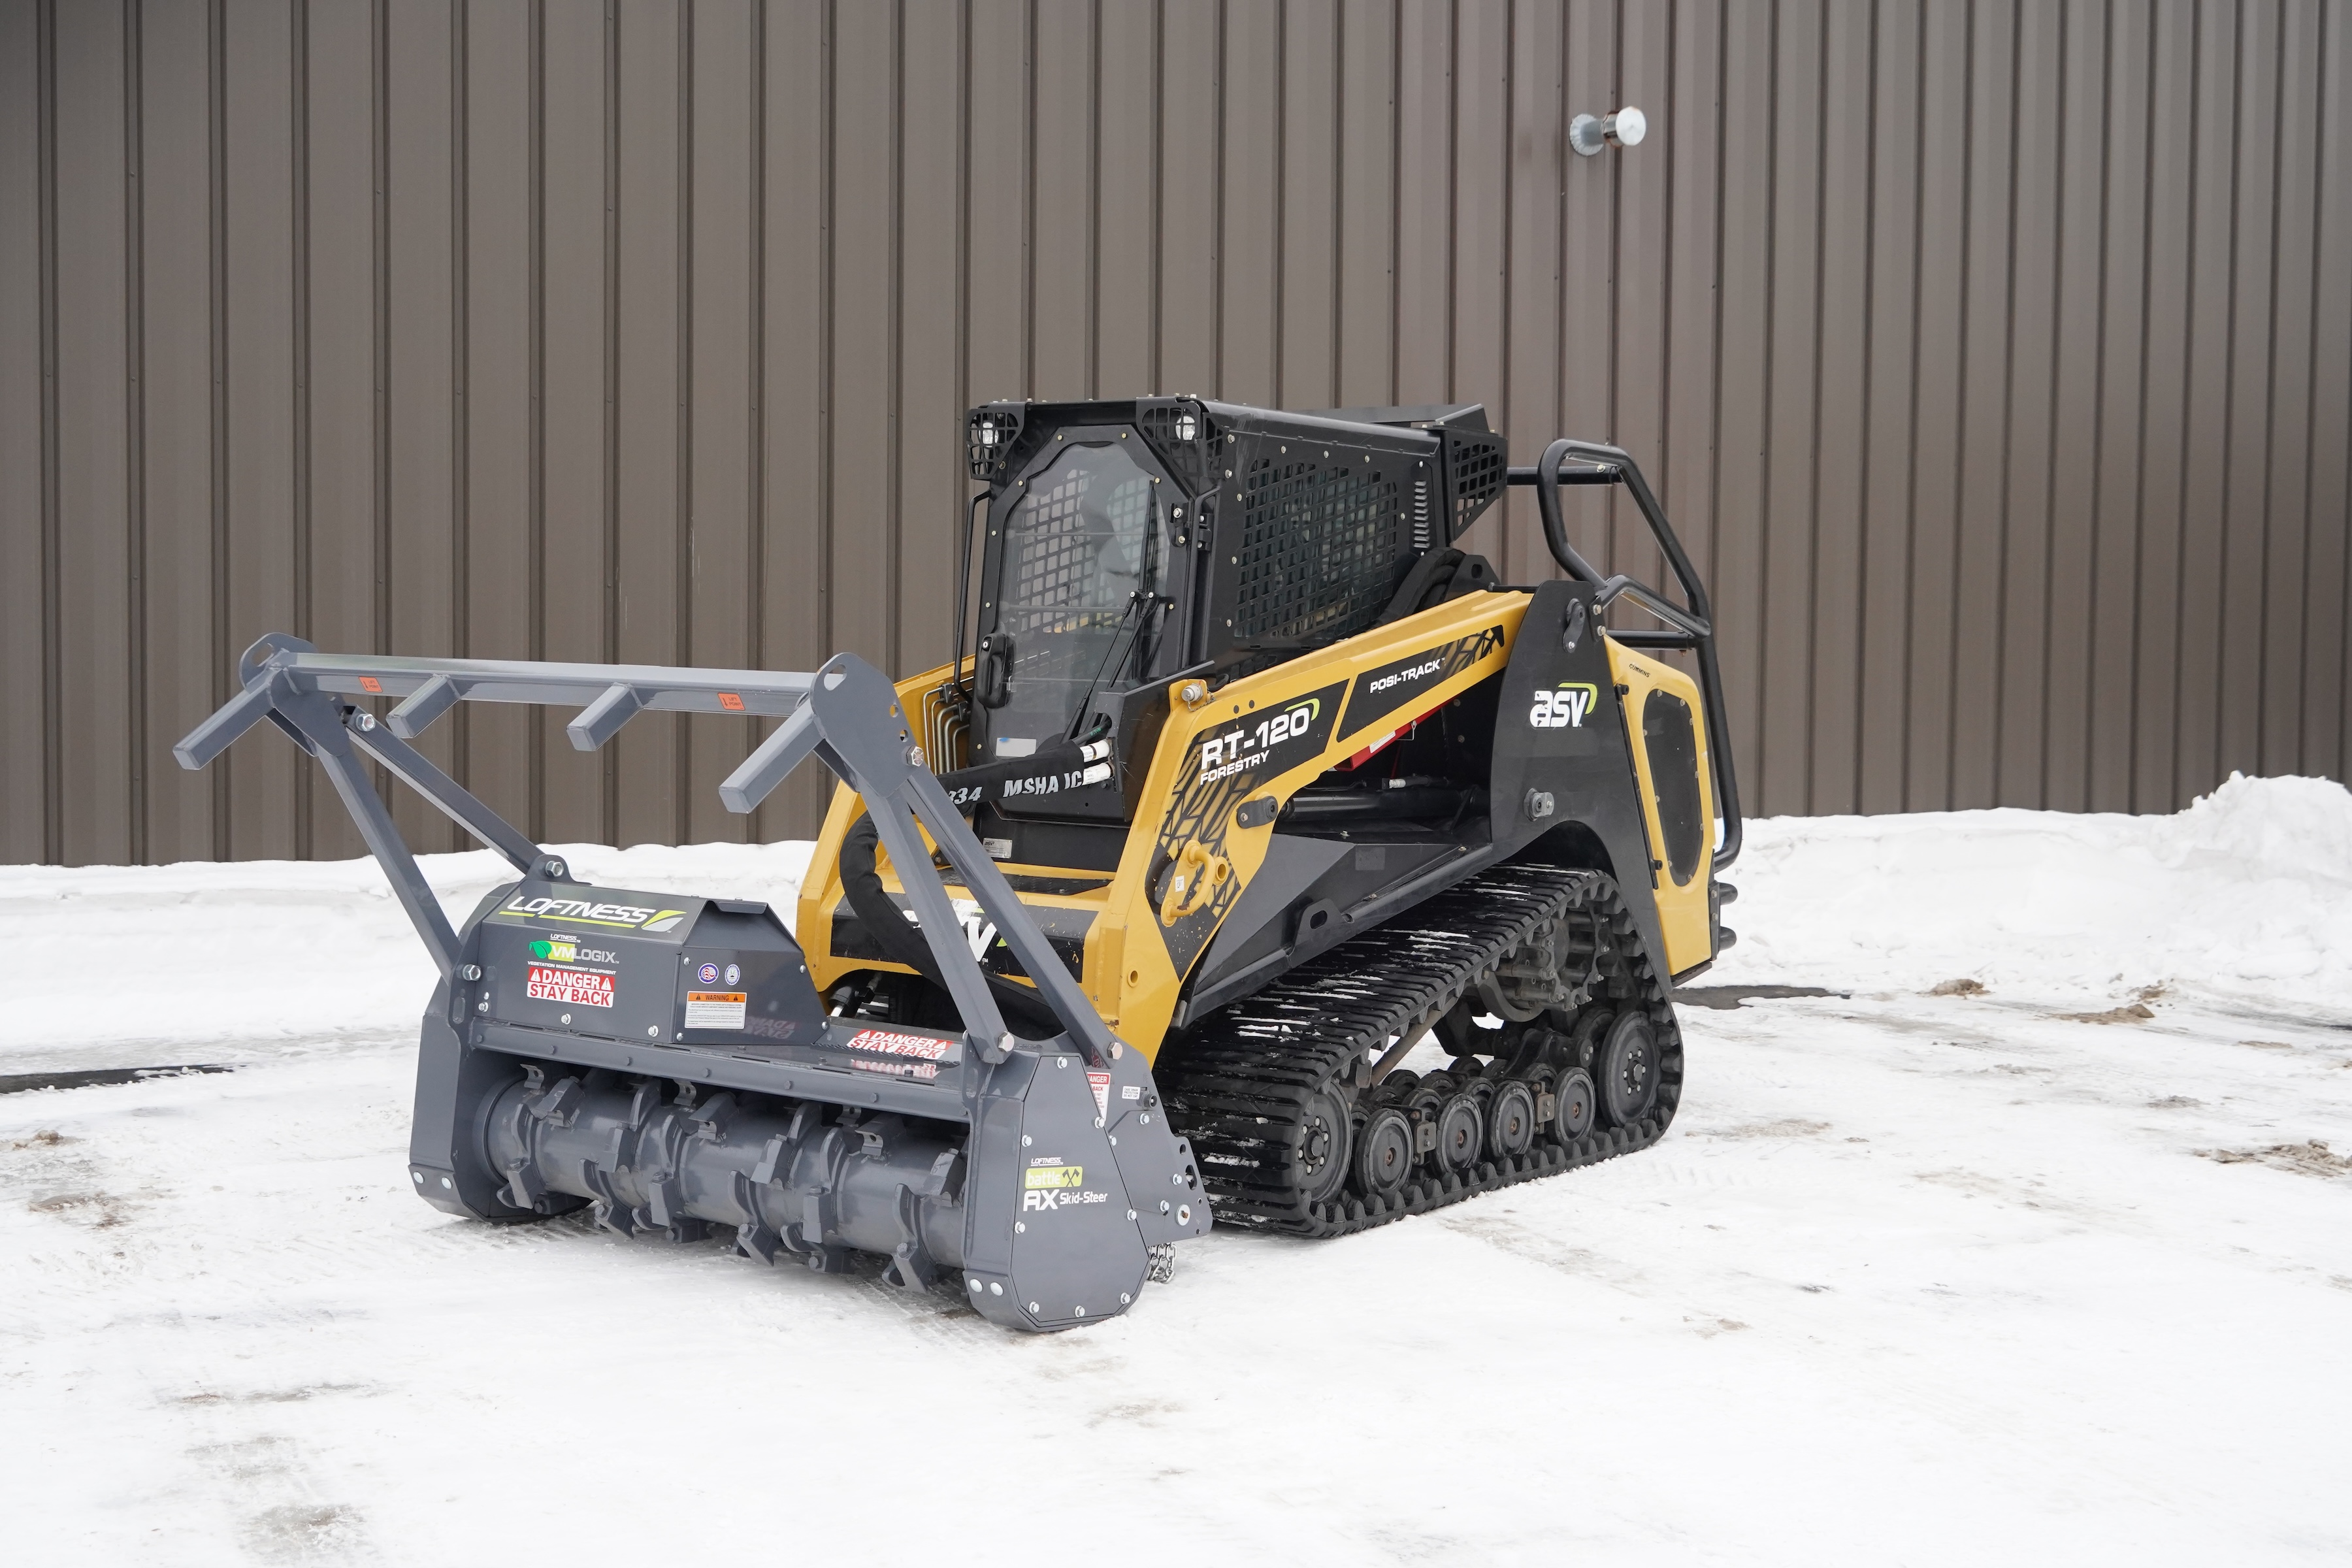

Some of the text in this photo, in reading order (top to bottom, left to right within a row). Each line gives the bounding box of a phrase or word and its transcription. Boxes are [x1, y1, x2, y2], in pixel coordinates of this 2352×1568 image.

[1370, 659, 1441, 693] POSI-TRACK
[1629, 663, 1650, 678] CUMMINS
[1201, 708, 1310, 770] RT-120
[1200, 749, 1270, 786] FORESTRY
[1003, 775, 1059, 798] MSHA
[507, 896, 657, 923] LOFTNESS
[542, 970, 600, 990] DANGER
[530, 983, 610, 1006] STAY BACK
[851, 1039, 941, 1058] STAY BACK
[870, 1032, 937, 1048] DANGER
[1026, 1171, 1061, 1186] battle
[1023, 1188, 1108, 1211] AX Skid-Steer
